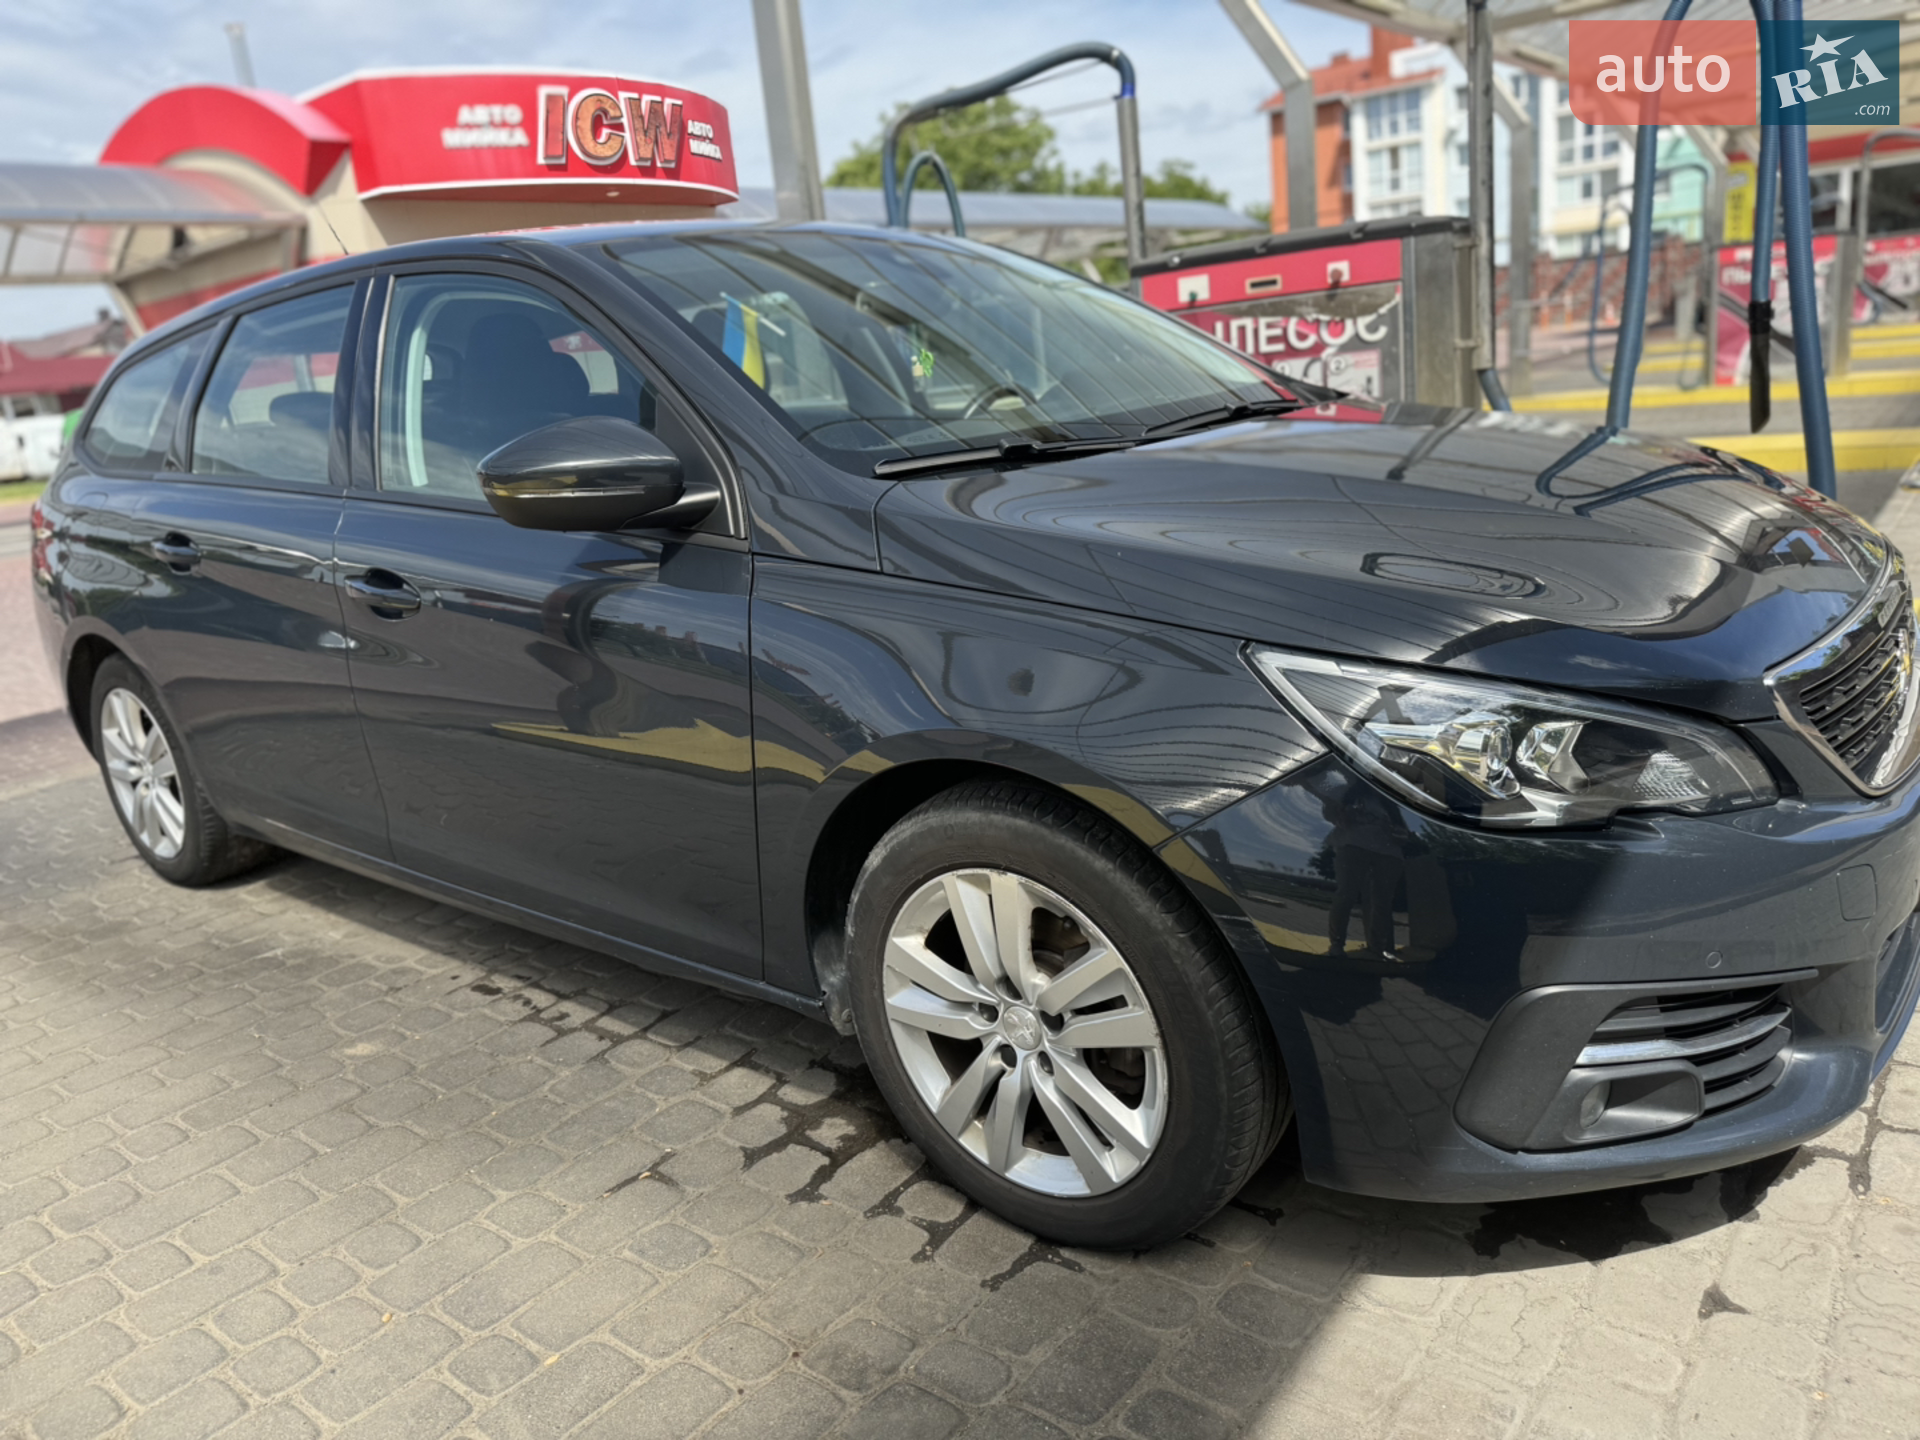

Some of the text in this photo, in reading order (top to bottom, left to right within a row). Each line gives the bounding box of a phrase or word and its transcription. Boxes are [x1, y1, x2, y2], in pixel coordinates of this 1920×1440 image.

[457, 104, 523, 126] АВТО
[537, 85, 683, 168] ICW
[687, 119, 713, 139] АВТО
